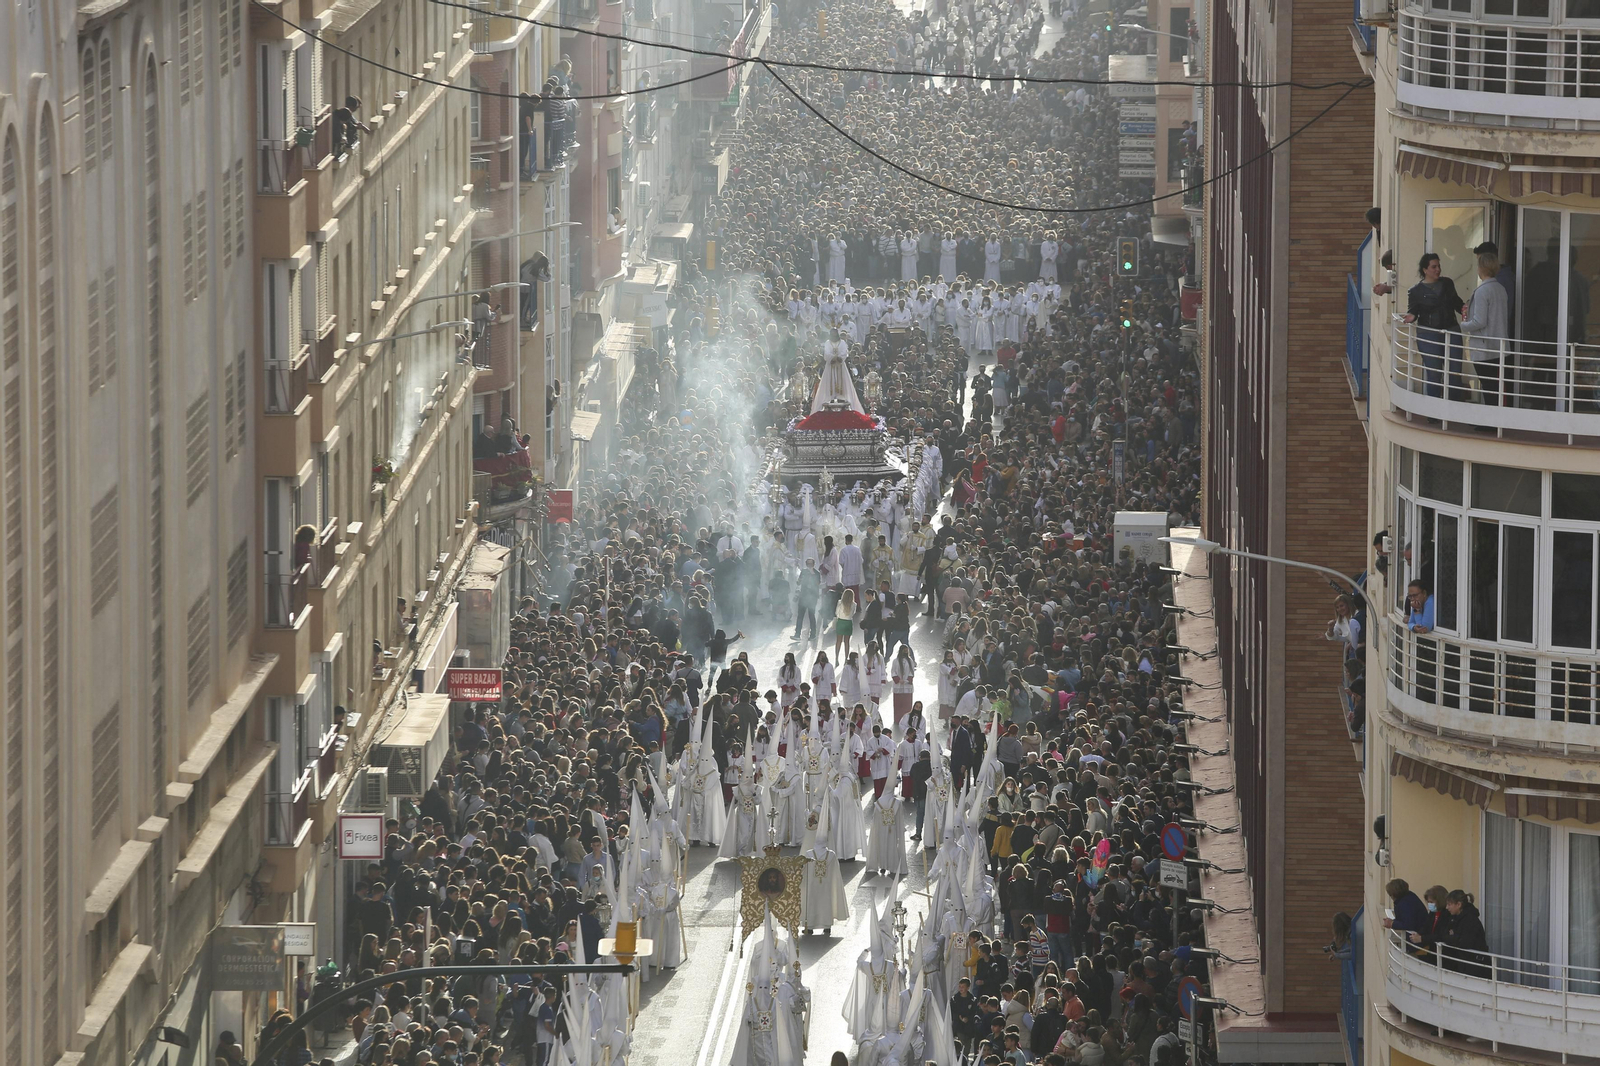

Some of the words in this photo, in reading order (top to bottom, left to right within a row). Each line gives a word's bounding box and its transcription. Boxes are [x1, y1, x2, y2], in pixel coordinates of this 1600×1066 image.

[450, 673, 473, 684] SUPER
[474, 673, 496, 685] BAZAR
[354, 832, 378, 842] Fixea
